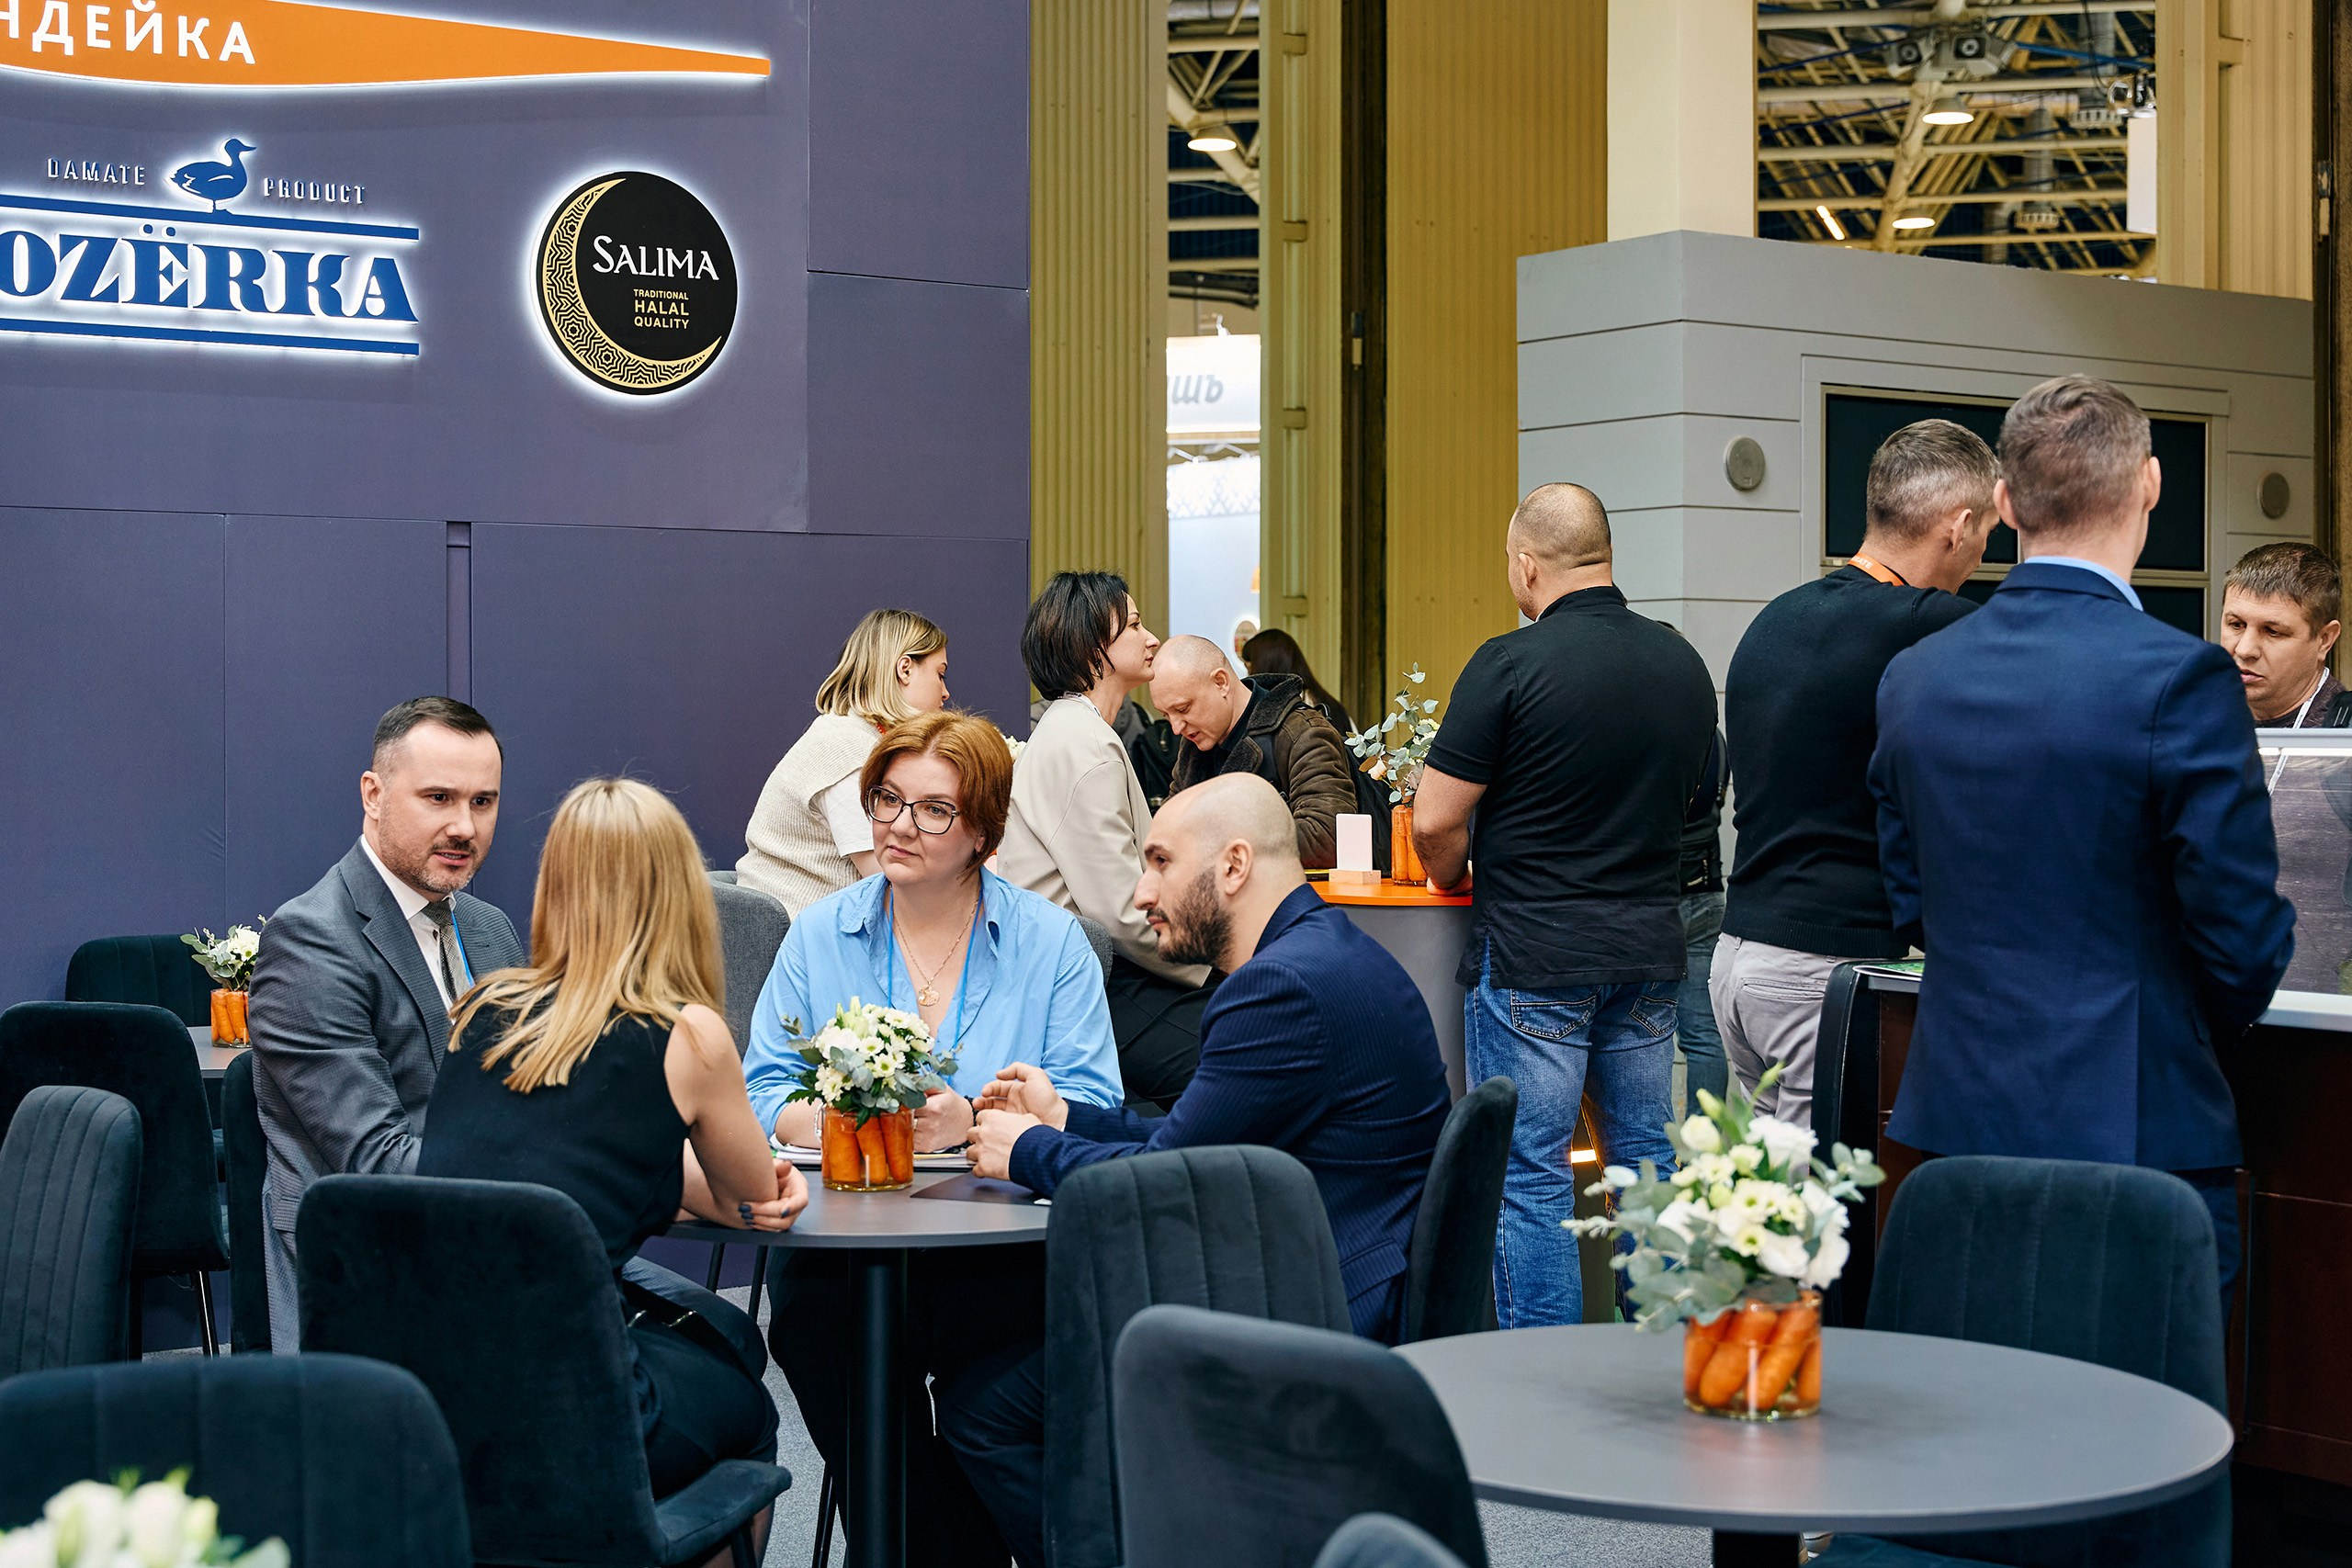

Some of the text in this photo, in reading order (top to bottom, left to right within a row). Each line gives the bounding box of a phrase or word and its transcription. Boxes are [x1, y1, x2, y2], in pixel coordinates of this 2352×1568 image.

[47, 158, 146, 186] DAMATE
[263, 177, 366, 205] PRODUCT
[593, 235, 719, 280] SALIMA
[633, 288, 689, 300] TRADITIONAL
[634, 299, 689, 316] HALAL
[634, 316, 689, 329] QUALITY
